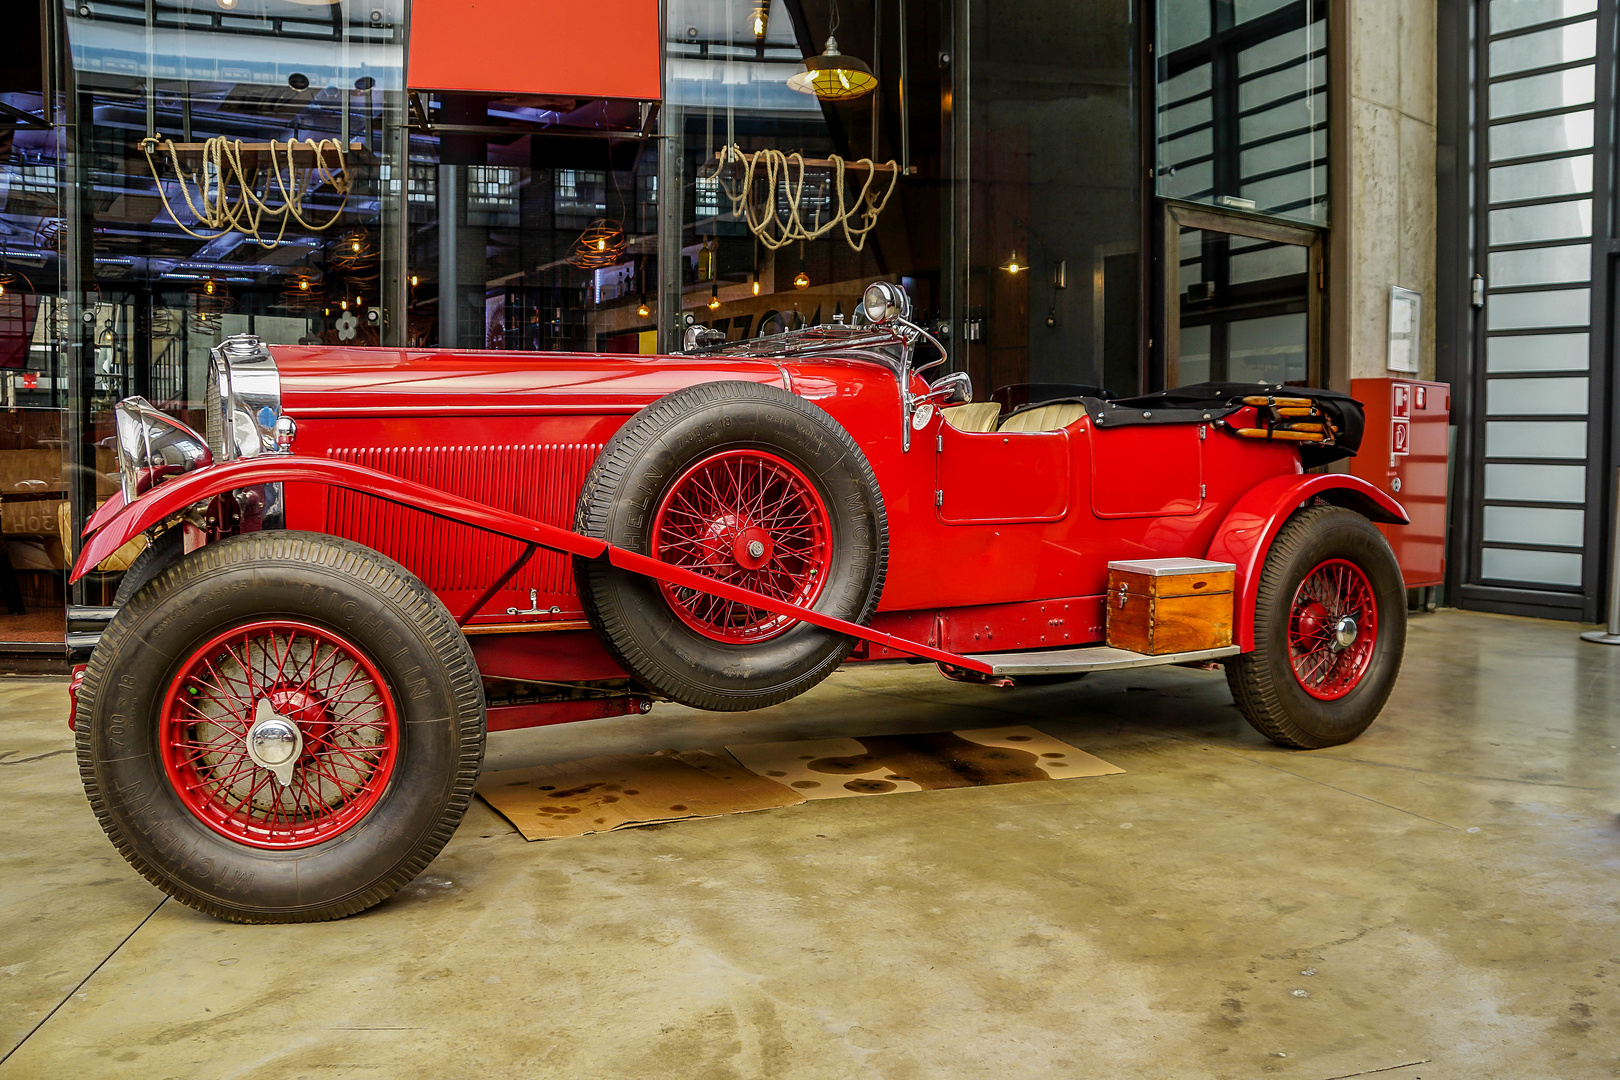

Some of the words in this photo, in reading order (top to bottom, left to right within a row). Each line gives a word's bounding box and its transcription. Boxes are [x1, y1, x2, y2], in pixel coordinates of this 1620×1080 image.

[719, 415, 732, 429] 18
[300, 583, 431, 701] MICHELIN
[117, 674, 136, 691] 18
[119, 781, 255, 892] MICHELIN
